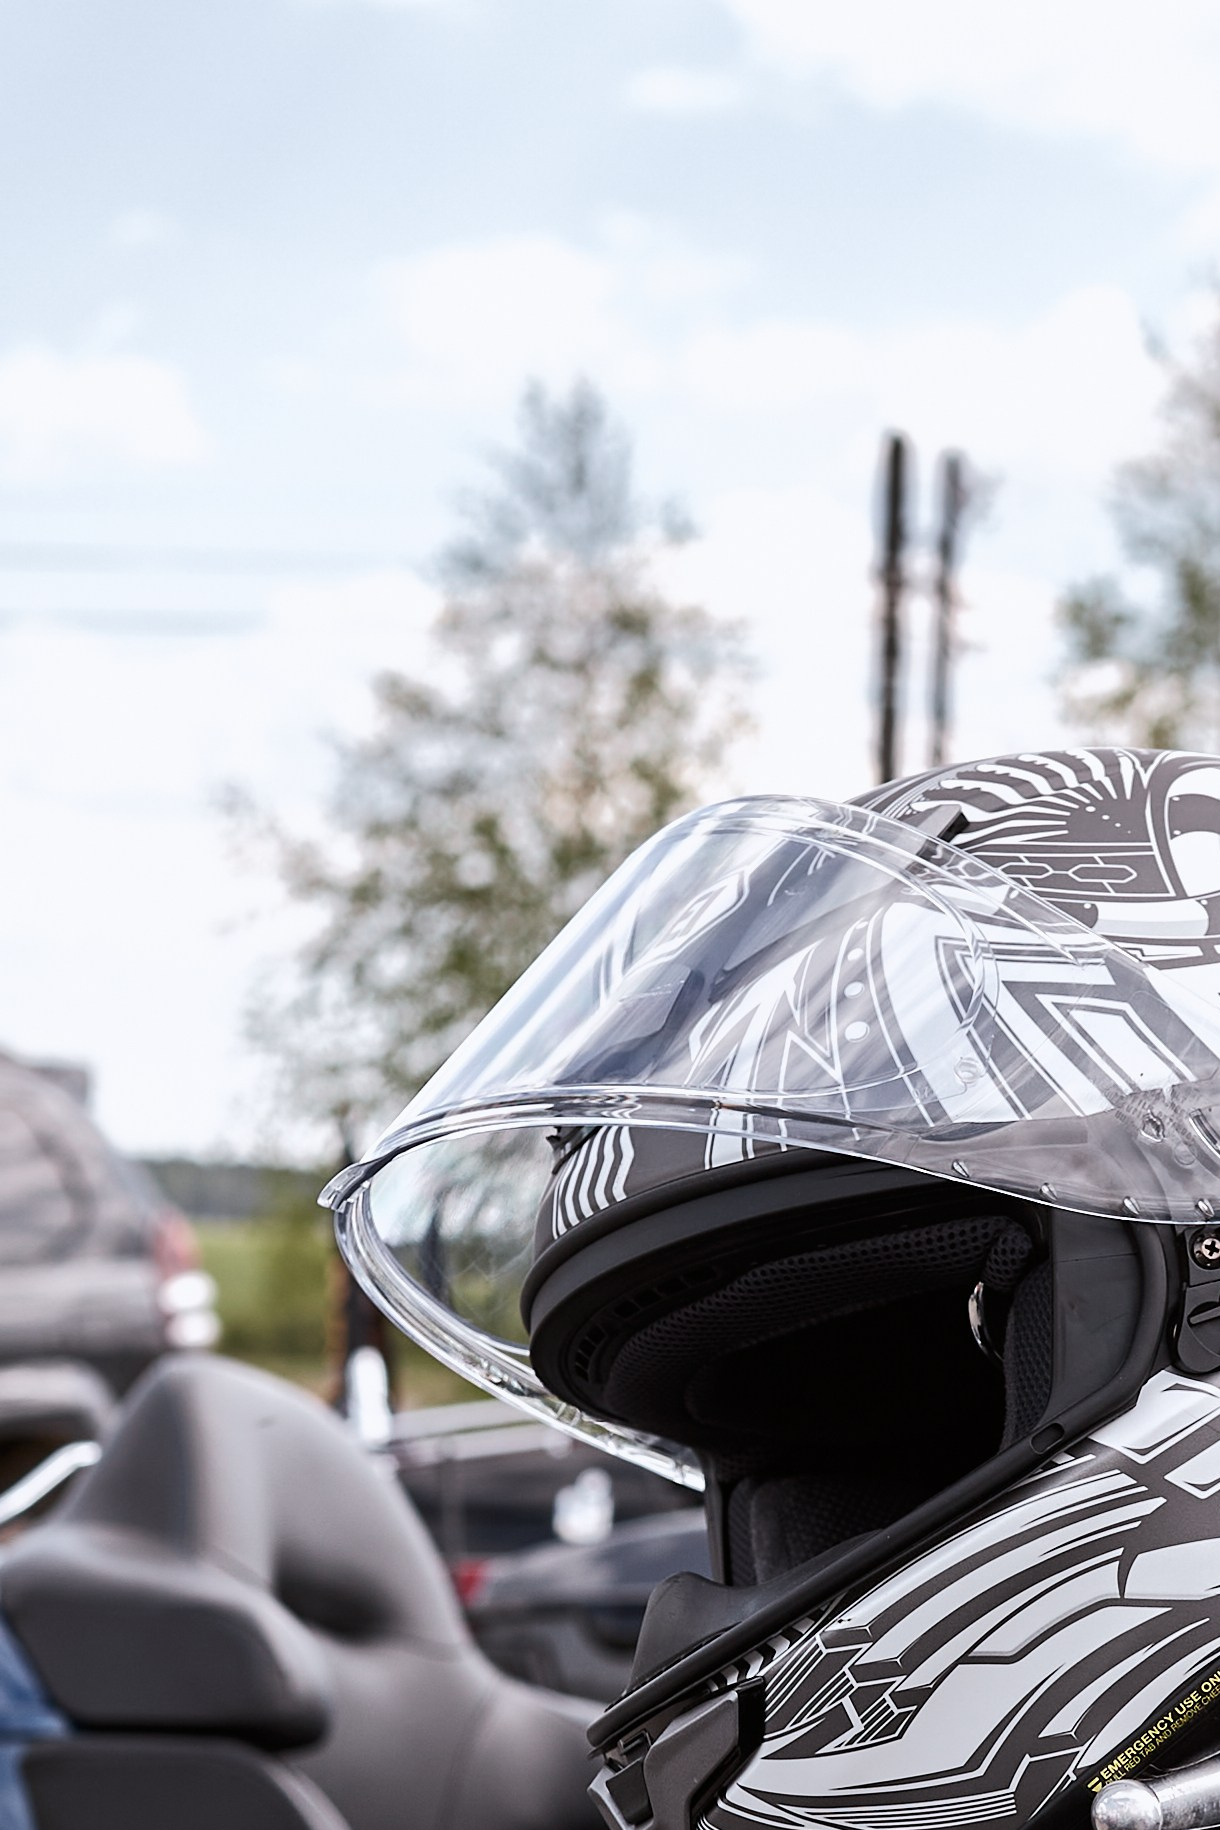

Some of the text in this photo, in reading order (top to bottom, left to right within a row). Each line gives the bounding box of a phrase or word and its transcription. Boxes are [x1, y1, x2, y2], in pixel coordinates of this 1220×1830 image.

[1100, 1712, 1173, 1779] EMERGENCY
[1174, 1690, 1202, 1715] USE
[1123, 1755, 1141, 1771] RED
[1139, 1742, 1156, 1758] TAB
[1155, 1729, 1172, 1746] AND
[1170, 1703, 1202, 1732] REMOVE
